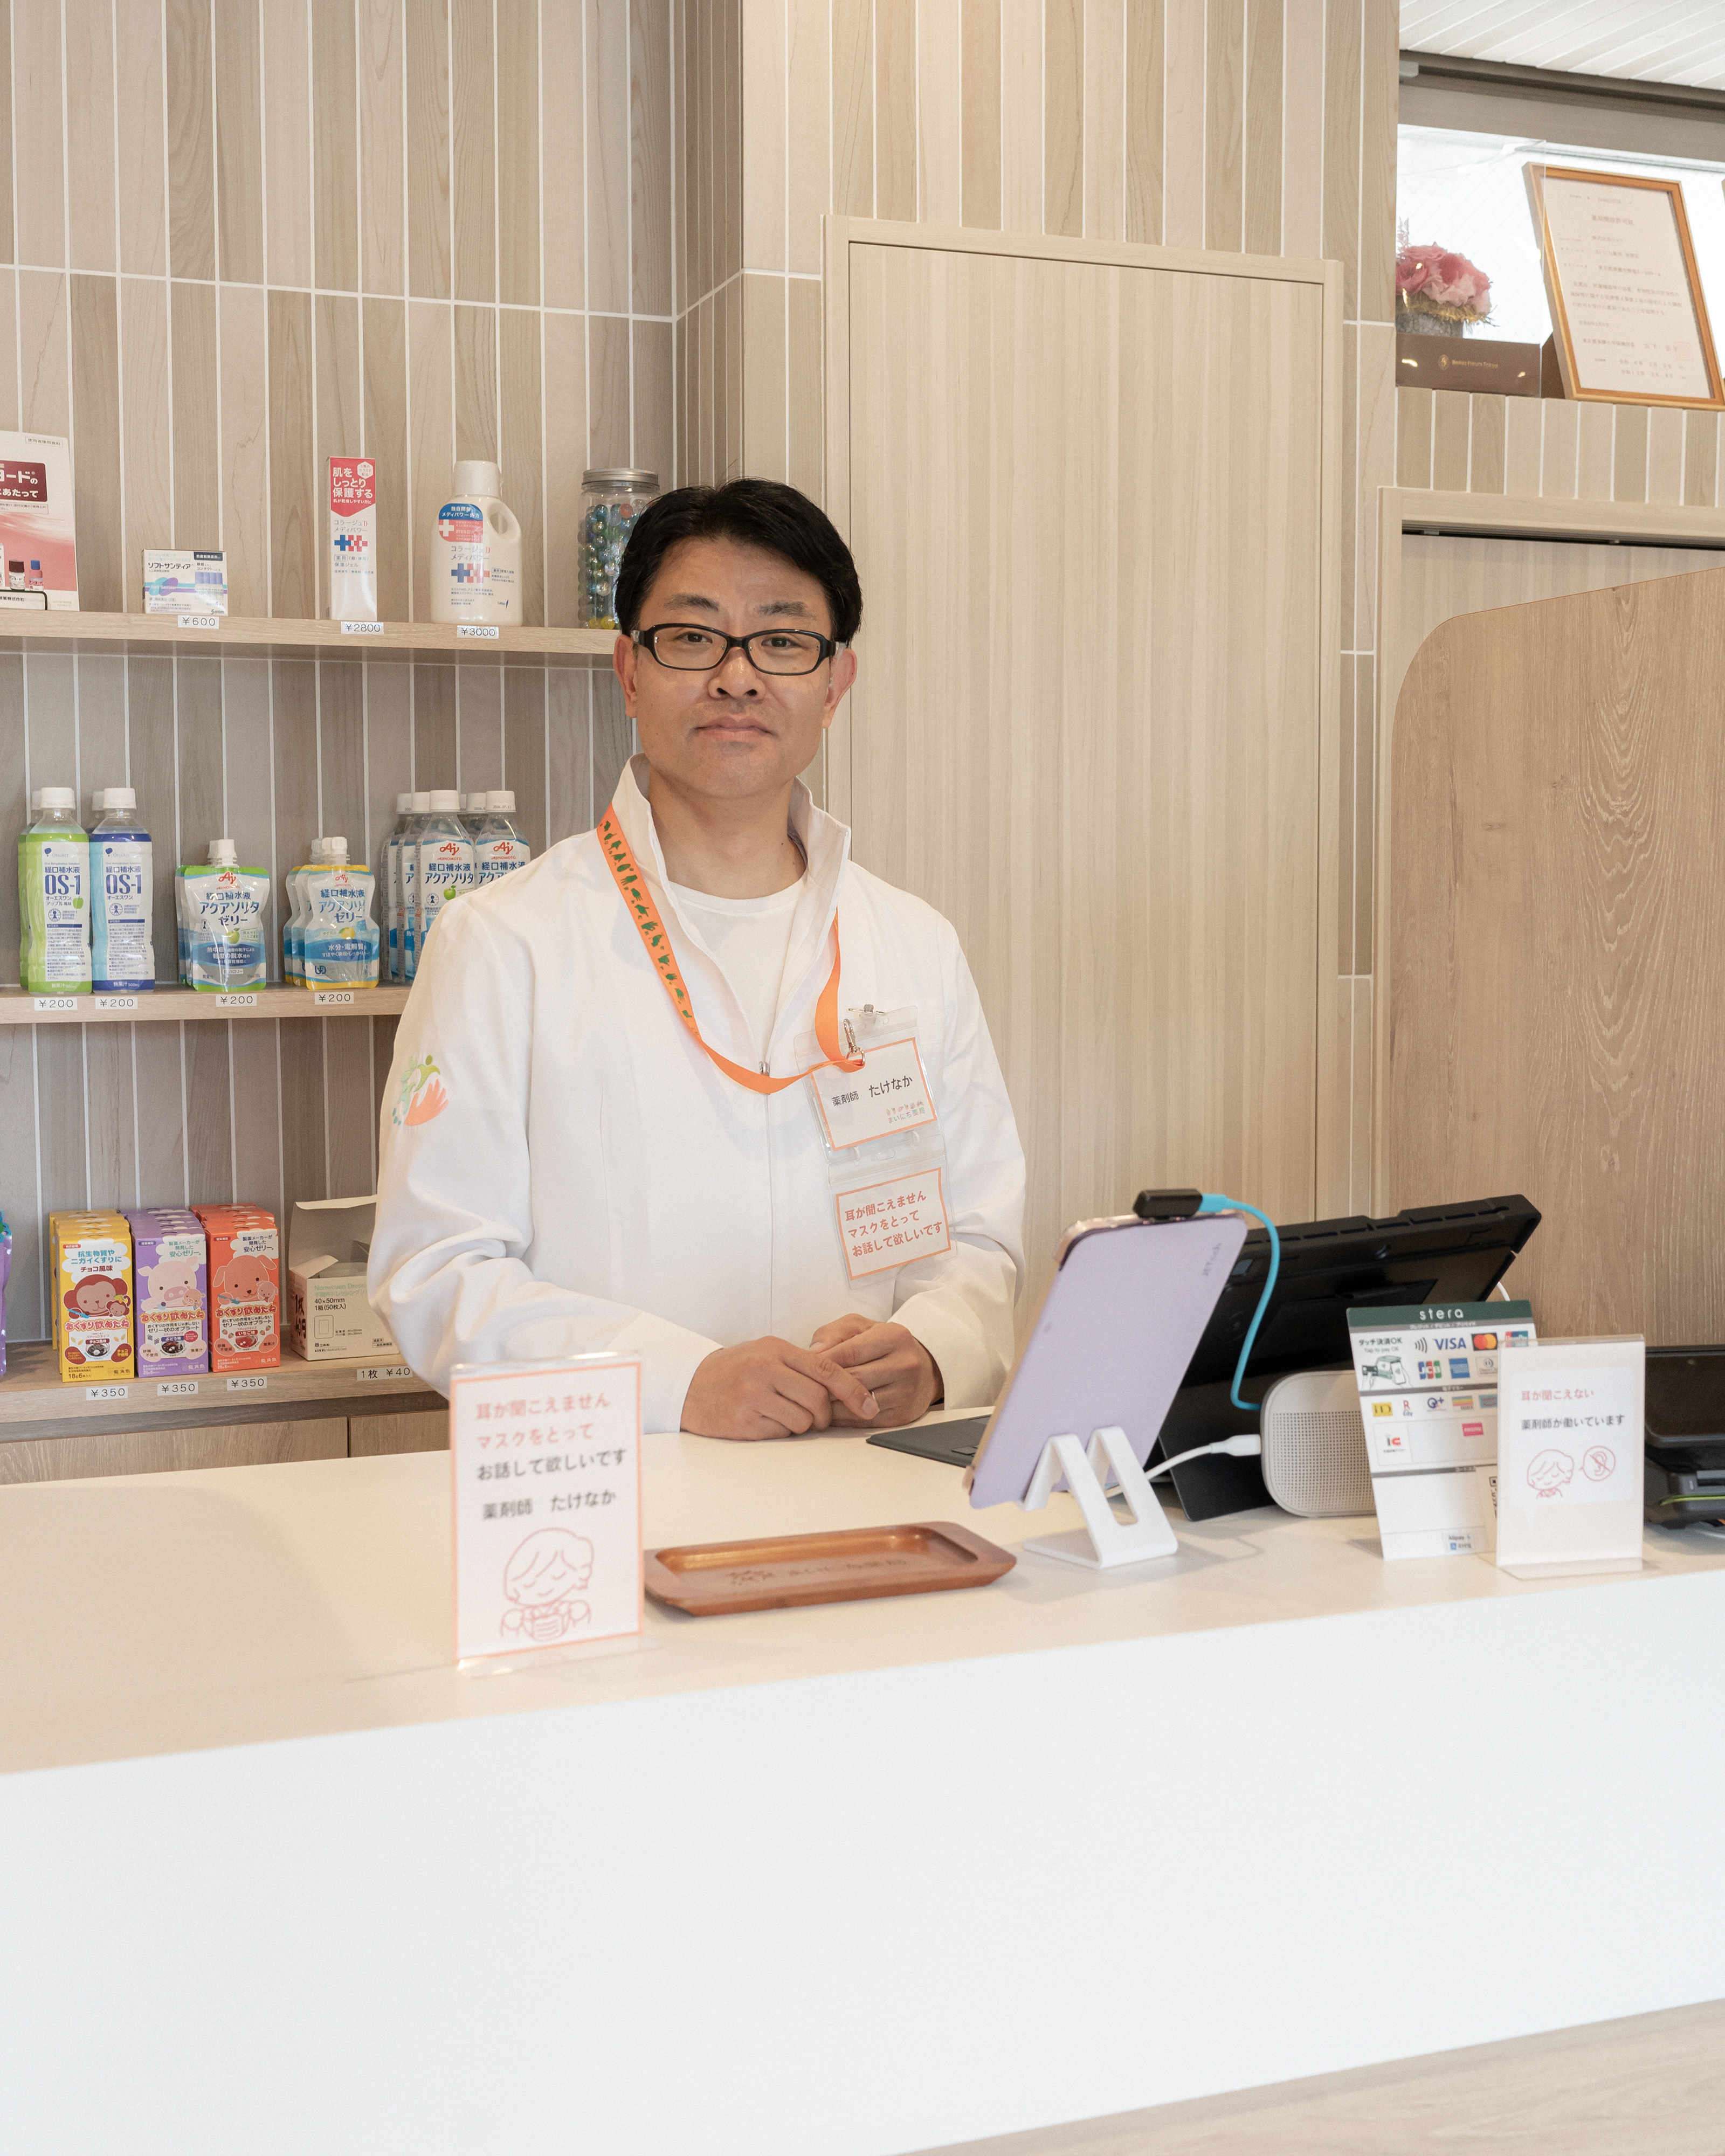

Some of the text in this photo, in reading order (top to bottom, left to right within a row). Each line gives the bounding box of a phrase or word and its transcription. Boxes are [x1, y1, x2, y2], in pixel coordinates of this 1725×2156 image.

[333, 467, 353, 477] 肌を
[333, 478, 366, 488] しっとり
[0, 488, 38, 498] あたって
[333, 487, 373, 499] 保護する
[182, 617, 216, 626] ¥600
[346, 624, 381, 633] ¥2800
[461, 627, 495, 637] ¥3000
[106, 874, 142, 894] OS-1
[425, 873, 474, 884] アクアソリタ
[45, 874, 80, 895] OS-1
[206, 891, 251, 900] 経口補水液
[321, 889, 365, 898] 経口補水液
[199, 901, 259, 914] アクアソリタ
[218, 915, 247, 925] ゼリー
[334, 912, 362, 923] ゼリー
[39, 999, 73, 1008] ¥200
[100, 999, 134, 1007] ¥200
[220, 996, 253, 1004] ¥200
[319, 994, 350, 1002] ¥200
[832, 1075, 913, 1107] 薬剤師 たけなか
[888, 1107, 926, 1123] まいにち薬局
[845, 1191, 926, 1221] 耳が聞こえません
[848, 1210, 920, 1238] マスクをとって
[852, 1221, 942, 1257] お話して欲しいです
[78, 1249, 115, 1257] 抗生物質や
[71, 1256, 122, 1264] ニガイくすりに
[141, 1310, 205, 1322] おくすり飲めたね
[216, 1305, 277, 1316] おくすり飲めたね
[1419, 1308, 1464, 1321] stera
[65, 1319, 129, 1331] おくすり飲めたね
[1433, 1337, 1467, 1350] VISA
[361, 1370, 378, 1379] 1枚
[162, 1384, 195, 1393] ¥350
[231, 1378, 264, 1388] ¥350
[91, 1388, 125, 1397] ¥350
[1522, 1389, 1594, 1401] 耳が聞こえない
[477, 1393, 610, 1420] 耳が聞こえません
[1521, 1414, 1625, 1430] 薬剤師が働いています
[477, 1423, 593, 1449] マスクをとって
[477, 1448, 627, 1481] お話して欲しいです
[483, 1489, 616, 1520] 薬剤師 たけなか
